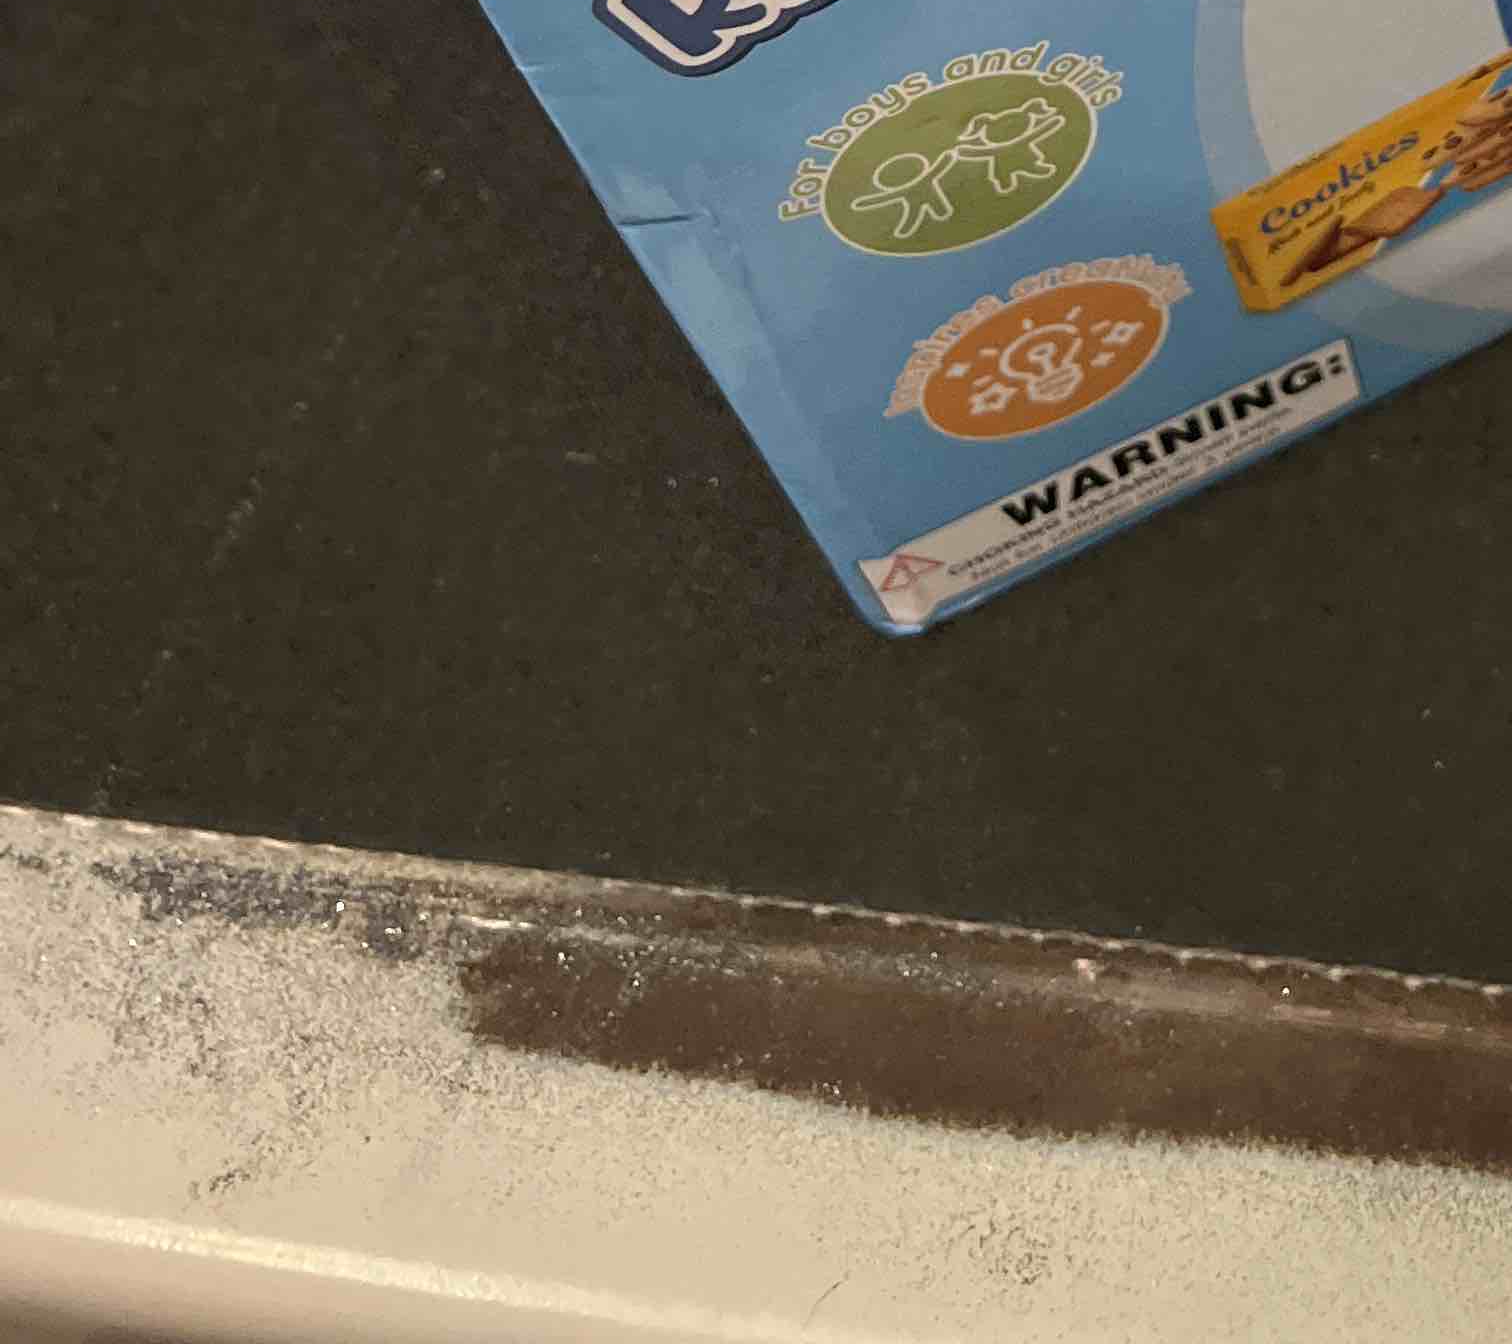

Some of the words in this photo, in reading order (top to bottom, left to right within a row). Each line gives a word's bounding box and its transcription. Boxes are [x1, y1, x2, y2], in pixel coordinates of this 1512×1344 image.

[778, 158, 829, 222] For
[806, 72, 930, 151] boys
[945, 40, 1050, 83] and
[1040, 52, 1125, 112] girls
[1259, 130, 1420, 235] Cookies
[1000, 354, 1348, 527] WARNING:
